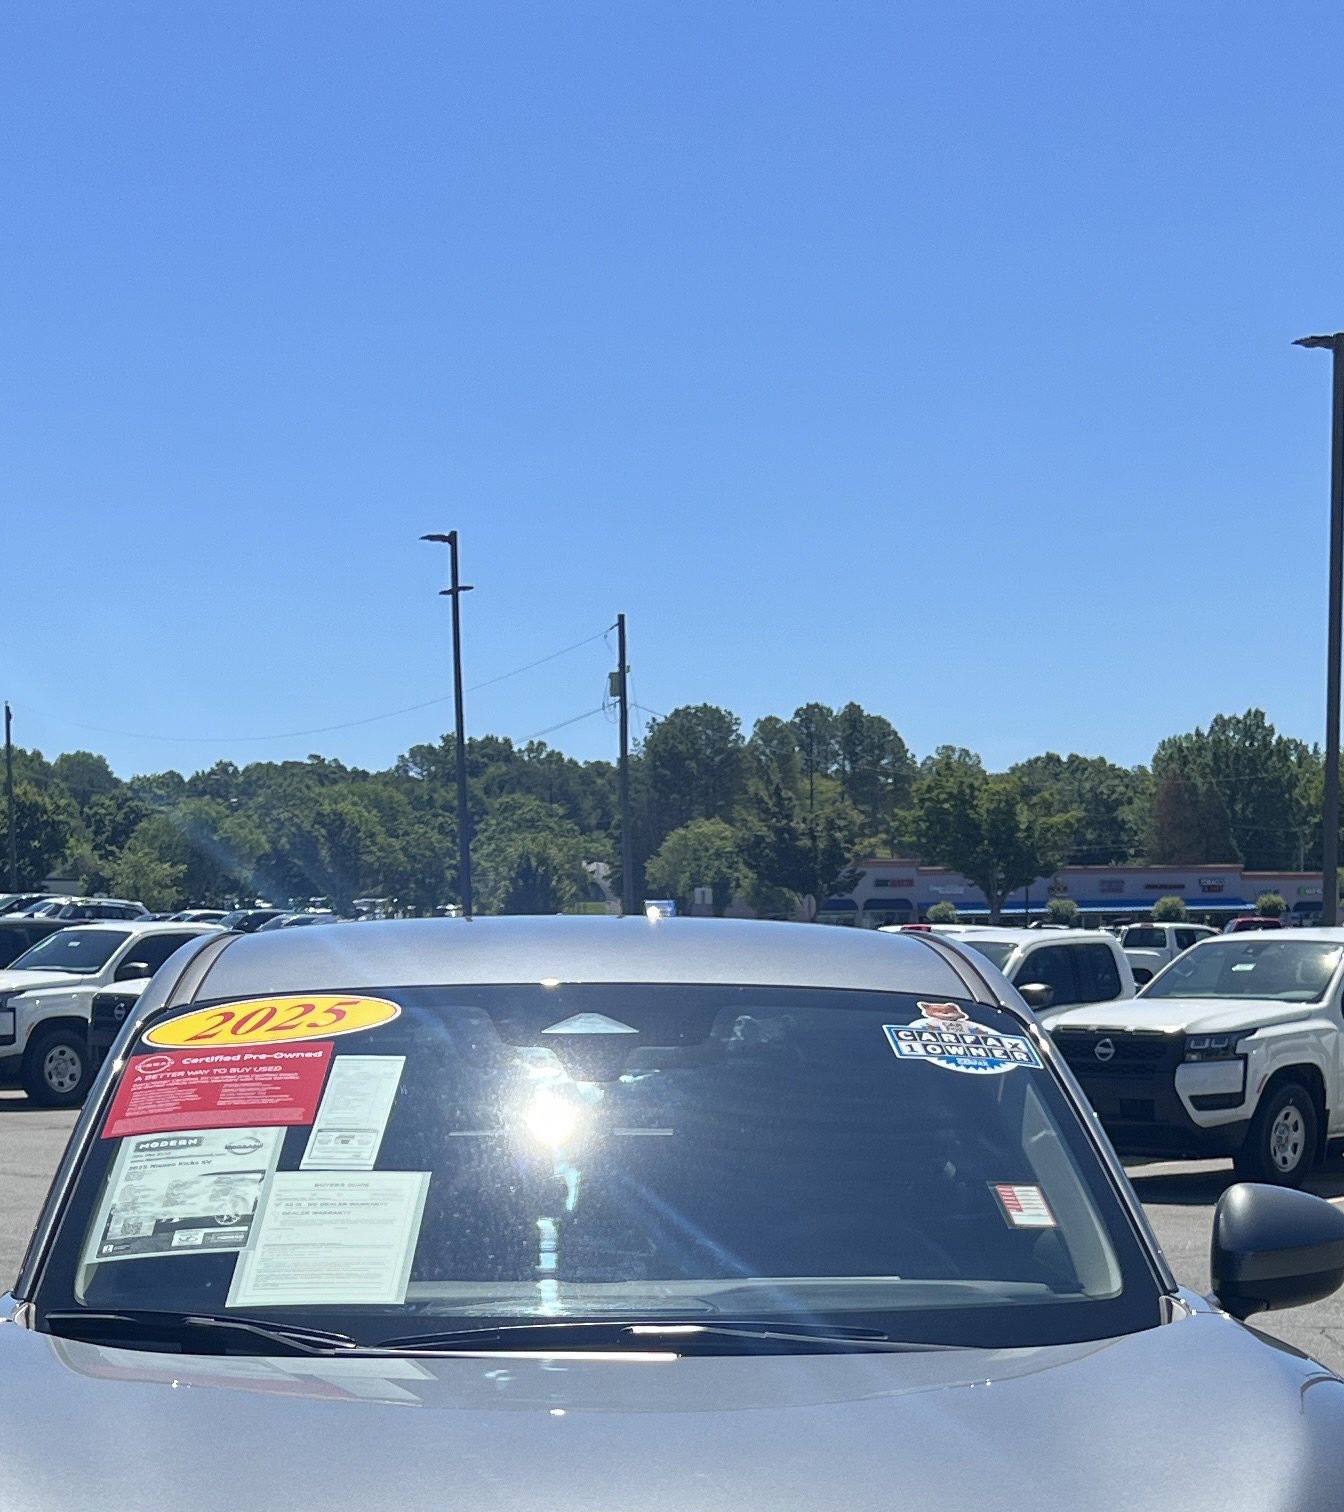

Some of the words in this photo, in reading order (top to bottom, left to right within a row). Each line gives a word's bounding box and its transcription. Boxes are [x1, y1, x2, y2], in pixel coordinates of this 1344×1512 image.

[184, 1000, 362, 1042] 2025
[897, 1030, 1024, 1050] CARFAX
[182, 1055, 241, 1065] Certified
[244, 1050, 323, 1061] Pre-Owned
[905, 1044, 918, 1053] 1
[926, 1044, 1031, 1062] OWNER
[145, 1071, 185, 1081] BETTER
[187, 1069, 211, 1077] WAY
[213, 1067, 227, 1075] TO
[229, 1066, 252, 1074] BUY
[139, 1137, 199, 1150] MODERN
